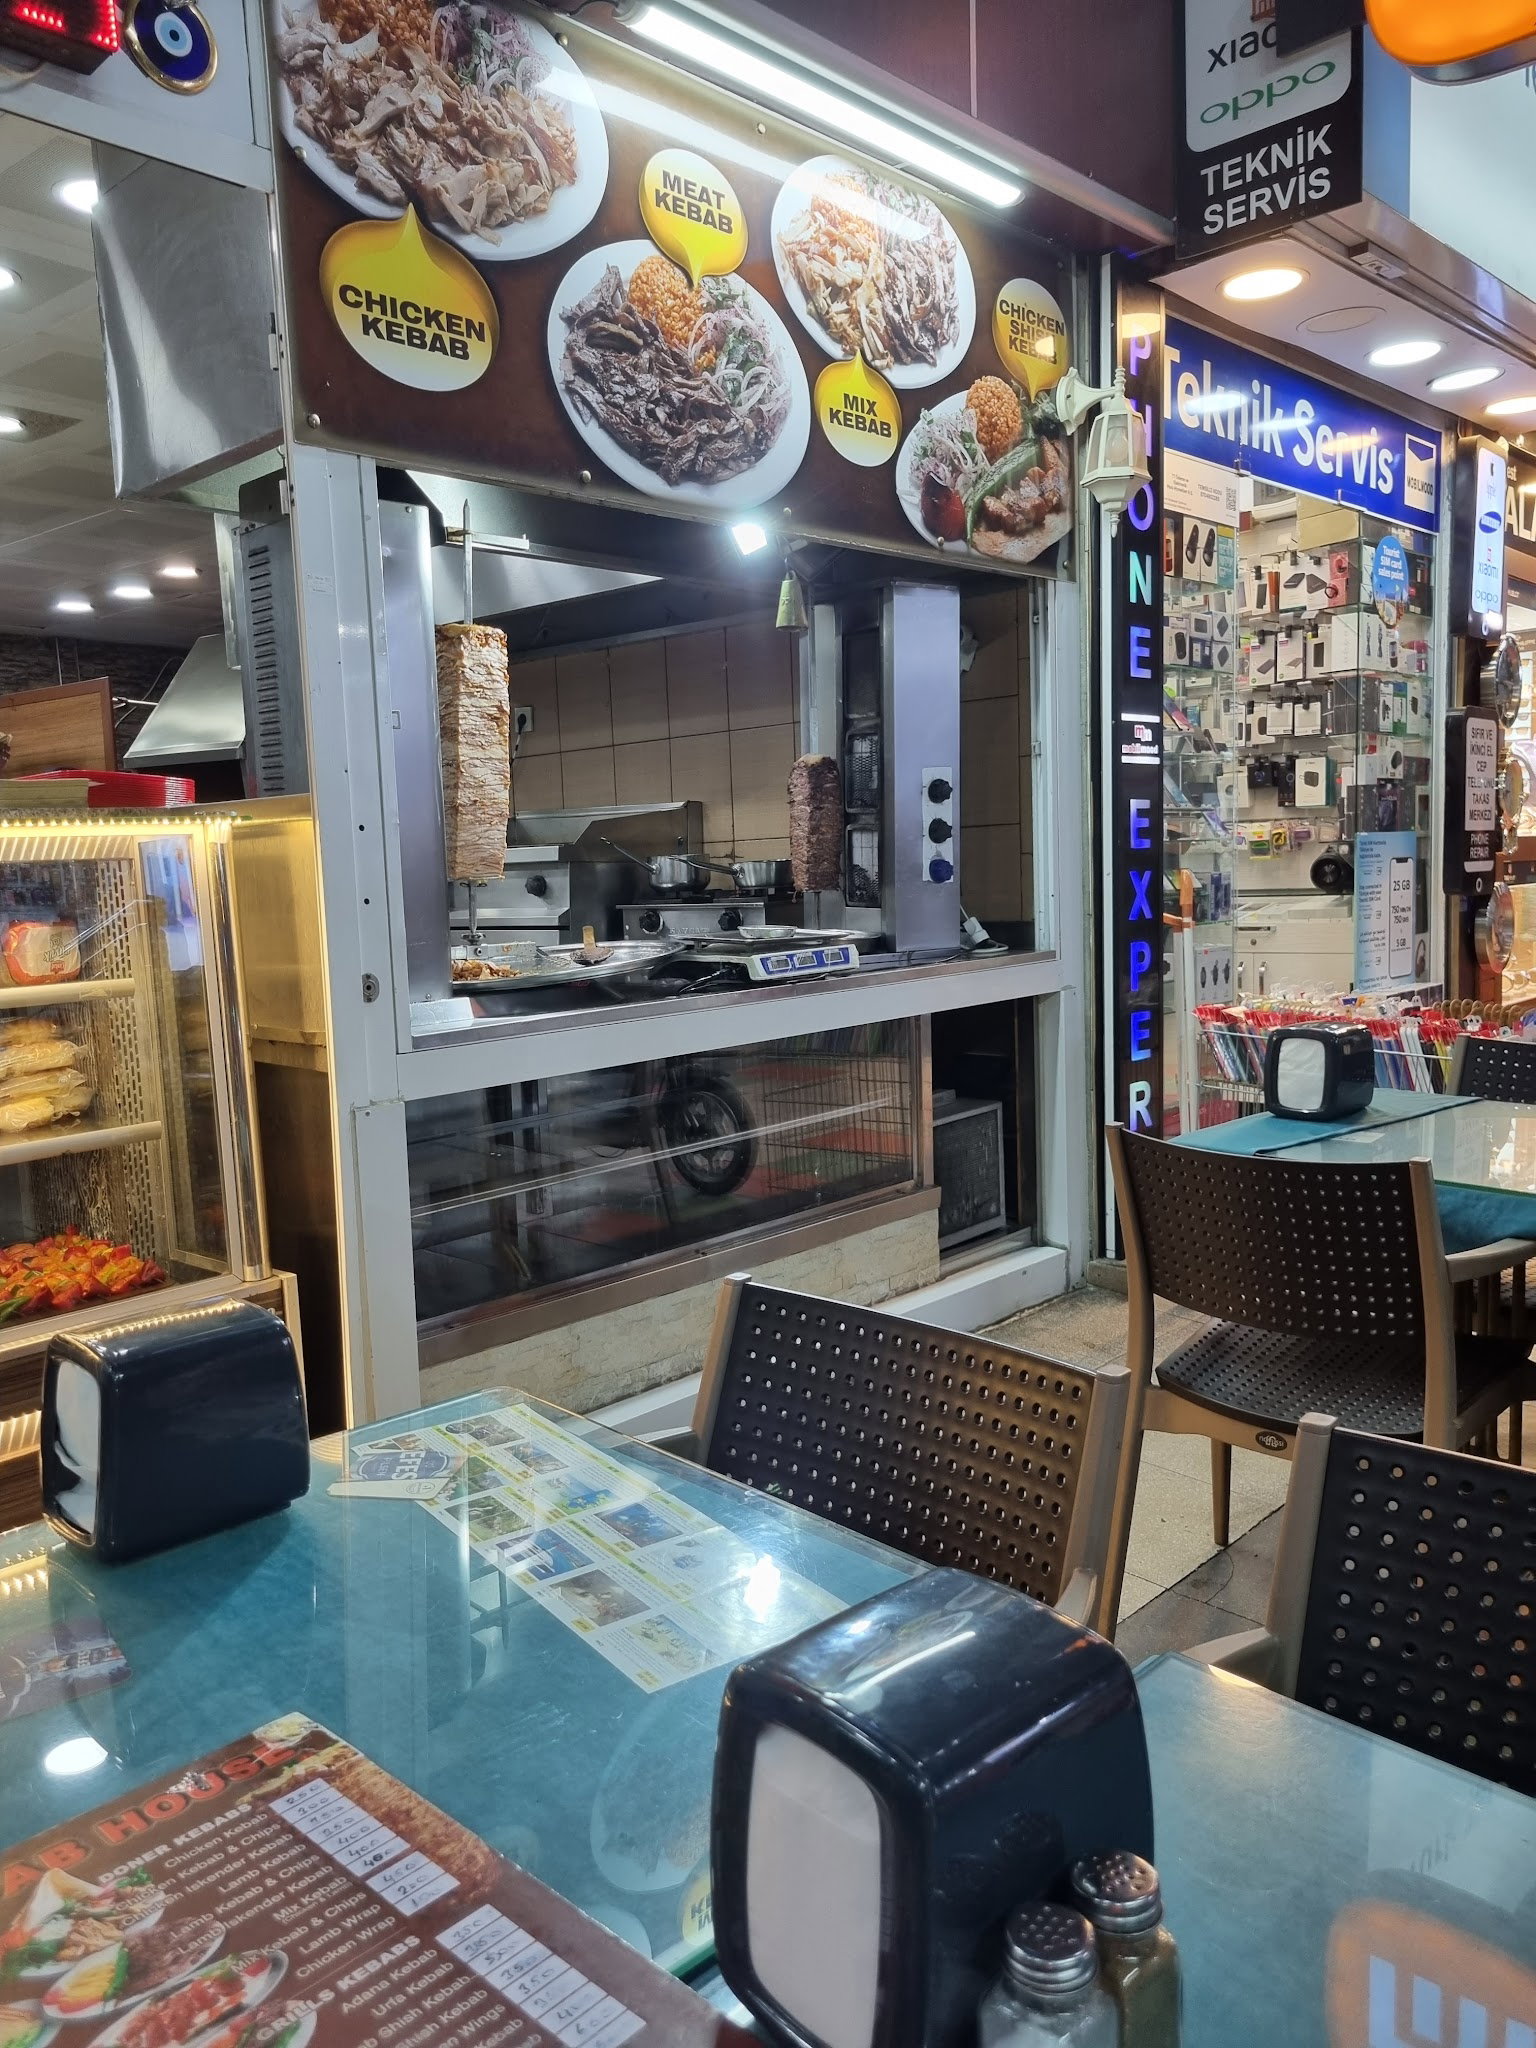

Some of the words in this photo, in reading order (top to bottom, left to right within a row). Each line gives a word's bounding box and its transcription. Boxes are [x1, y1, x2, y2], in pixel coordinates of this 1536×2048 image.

[1199, 61, 1336, 125] oppo
[1200, 122, 1333, 198] TEKNİK
[654, 188, 734, 235] KEBAB
[661, 169, 726, 211] MEAT
[1202, 165, 1332, 236] SERVİS
[338, 283, 486, 342] CHICKEN
[999, 299, 1065, 337] CHICKEN
[1010, 320, 1055, 345] SHIS
[361, 313, 471, 361] KEBAB
[829, 407, 892, 439] KEBAB
[843, 392, 878, 418] MIX
[1164, 344, 1285, 458] Teknik
[1292, 398, 1395, 496] Servis
[1378, 567, 1391, 578] sales
[1380, 555, 1391, 567] SIM
[1390, 559, 1403, 570] card
[1382, 544, 1401, 559] Tourist
[1475, 588, 1499, 605] oppo
[1486, 729, 1493, 741] VE
[1487, 745, 1494, 757] EL
[1475, 760, 1487, 772] CEP
[1471, 793, 1490, 805] TAKAS
[1469, 845, 1489, 859] REPAIR
[1470, 832, 1489, 847] PHONE
[1392, 880, 1401, 892] 25
[1401, 879, 1411, 891] GB
[391, 1450, 426, 1480] EFES
[98, 1743, 298, 1844] HOUSE
[97, 1843, 173, 1884] DONER
[173, 1802, 253, 1847] KEBABS
[164, 1836, 223, 1869] Chicken
[223, 1812, 268, 1839] Kebab
[114, 1877, 177, 1912] Chicken
[178, 1851, 225, 1880] Kebab
[227, 1844, 240, 1855] &
[240, 1822, 282, 1847] Chips
[122, 1891, 185, 1927] Chicken
[185, 1857, 247, 1894] Iskender
[248, 1833, 294, 1860] Kebab
[218, 1866, 260, 1894] Lamb
[261, 1843, 307, 1871] Kebab
[170, 1912, 215, 1940] Lamb
[215, 1885, 264, 1915] Kebab
[265, 1877, 279, 1888] &
[278, 1853, 321, 1880] Chips
[178, 1925, 224, 1955] Lamb
[223, 1891, 286, 1930] Iskender
[286, 1865, 334, 1894] Kebab
[272, 1903, 301, 1922] Mix
[301, 1875, 348, 1905] Kebab
[230, 1954, 261, 1974] Mix
[260, 1925, 310, 1956] Kebab
[310, 1916, 325, 1927] &
[324, 1890, 367, 1918] Chips
[295, 1938, 358, 1978] Chicken
[356, 1915, 396, 1942] Wrap
[299, 1926, 343, 1955] Lamb
[341, 1903, 382, 1930] Wrap
[256, 1988, 336, 2042] GRILLS
[336, 1935, 421, 1992] KEBABS
[341, 1977, 391, 2014] Adana
[389, 1949, 438, 1981] Kebab
[371, 1993, 407, 2018] Urfa
[406, 1961, 454, 1995] Kebab
[378, 2007, 423, 2039] Shish
[422, 1975, 471, 2010] Kebab
[438, 1989, 488, 2024] Kebab
[457, 2003, 506, 2038] Wings
